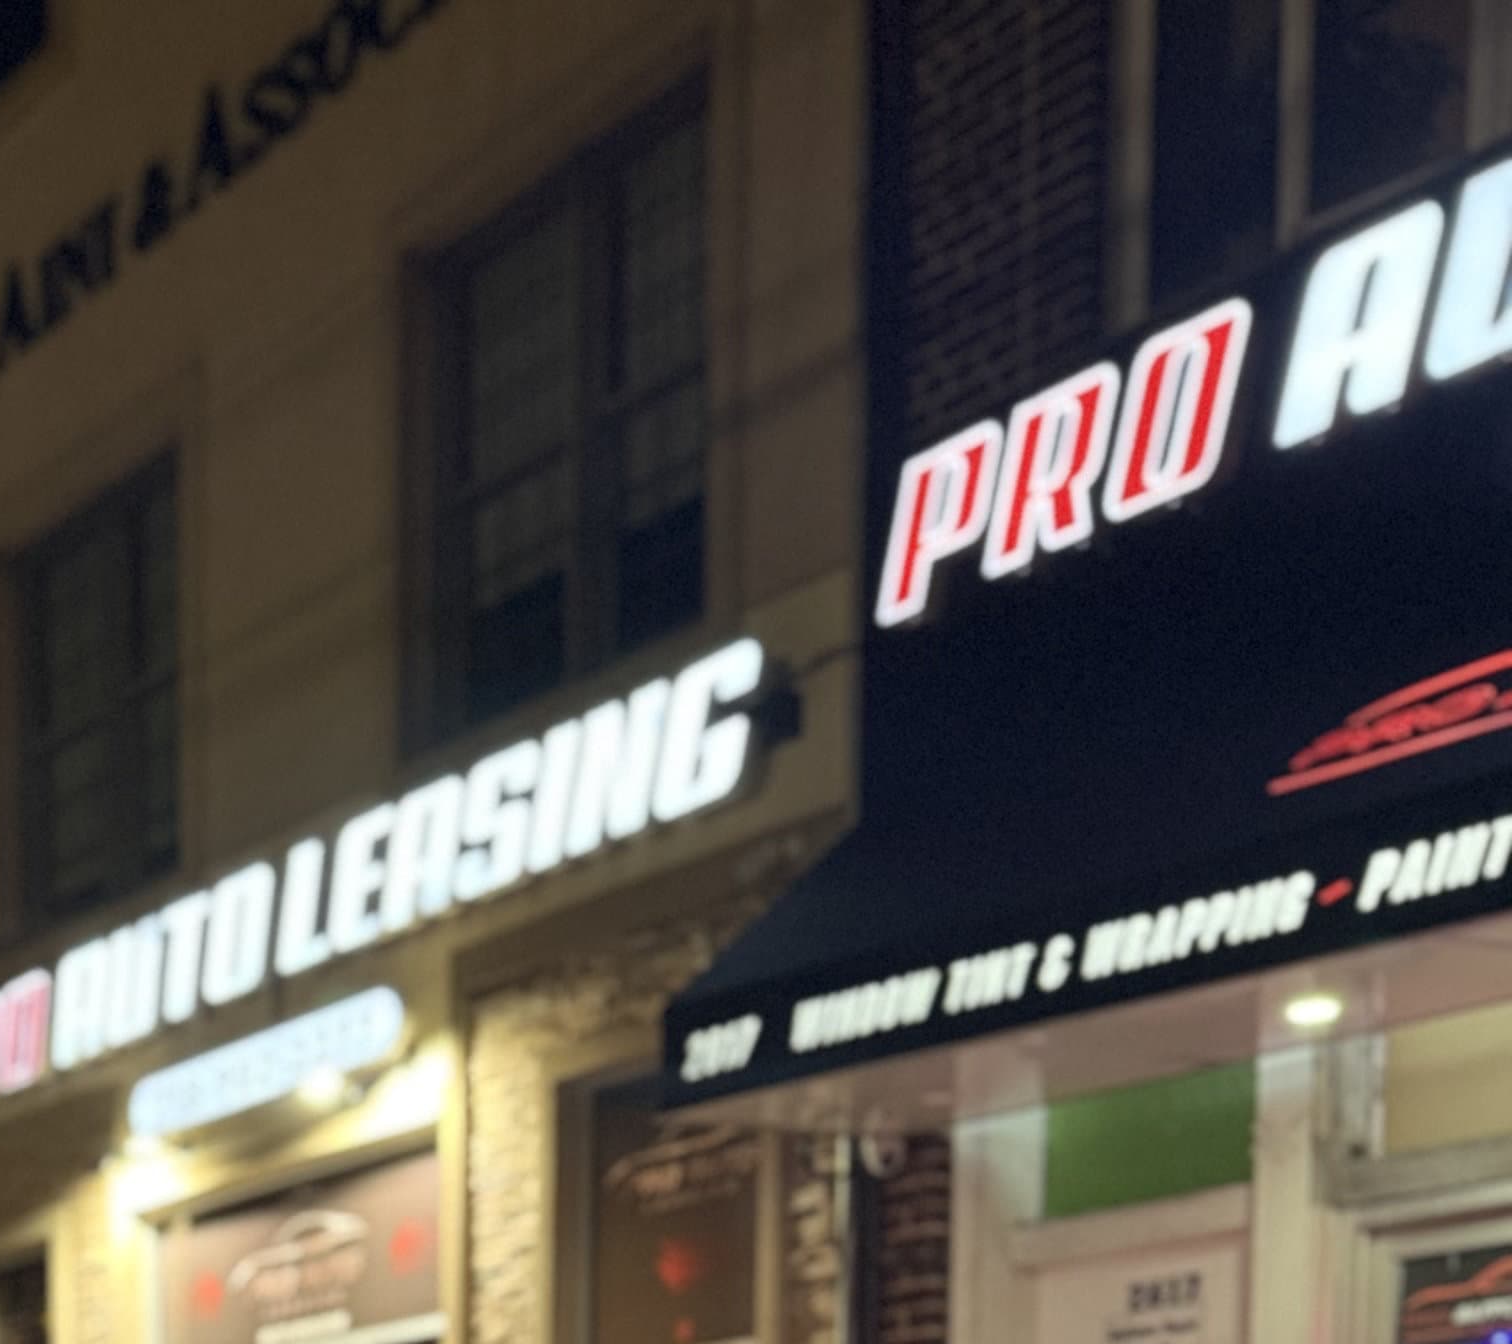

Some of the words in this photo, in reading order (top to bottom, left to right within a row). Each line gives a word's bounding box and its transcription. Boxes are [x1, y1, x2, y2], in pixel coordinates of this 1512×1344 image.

[186, 0, 450, 210] ASSOC
[874, 297, 1254, 629] PRO
[50, 860, 277, 1072] AUTO
[275, 637, 765, 977] LEASING
[789, 965, 943, 1053] WINDOW
[942, 941, 1038, 1015] TINT
[1080, 870, 1316, 981] WRAPPING
